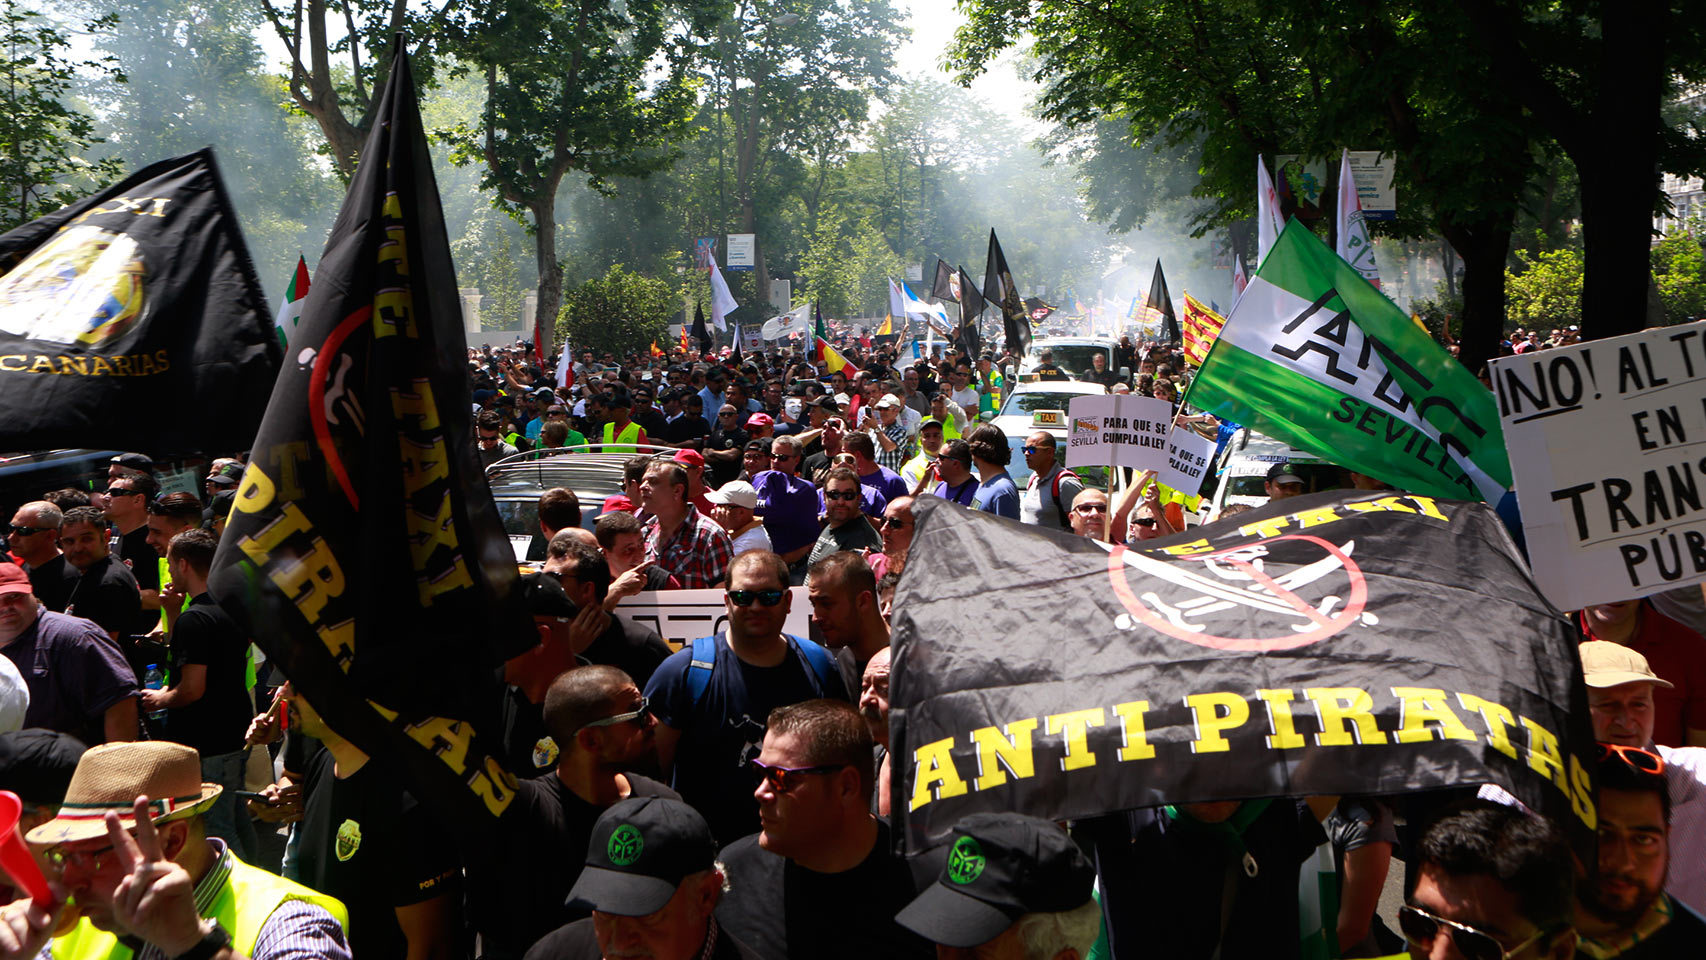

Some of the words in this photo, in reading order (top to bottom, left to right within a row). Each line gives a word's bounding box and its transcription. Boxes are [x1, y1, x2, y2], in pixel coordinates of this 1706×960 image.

[0, 349, 171, 377] CANARIAS
[1619, 342, 1668, 393] AL
[1670, 330, 1706, 378] T
[1040, 413, 1057, 423] TAXI
[1103, 417, 1128, 429] PARA
[1133, 418, 1151, 432] QUE
[1155, 422, 1166, 435] SE
[1632, 405, 1687, 450] EN
[1071, 437, 1098, 447] SEVILLA
[1103, 432, 1138, 446] CUMPLA
[1140, 435, 1150, 447] LA
[1152, 437, 1166, 450] LEY
[1332, 397, 1475, 497] SEVILLA
[1179, 449, 1194, 463] QUE
[1196, 456, 1206, 468] SE
[1180, 463, 1189, 474] LA
[1188, 467, 1201, 479] LEY
[909, 700, 1156, 812] ANTI
[1183, 686, 1599, 831] PIRATAS
